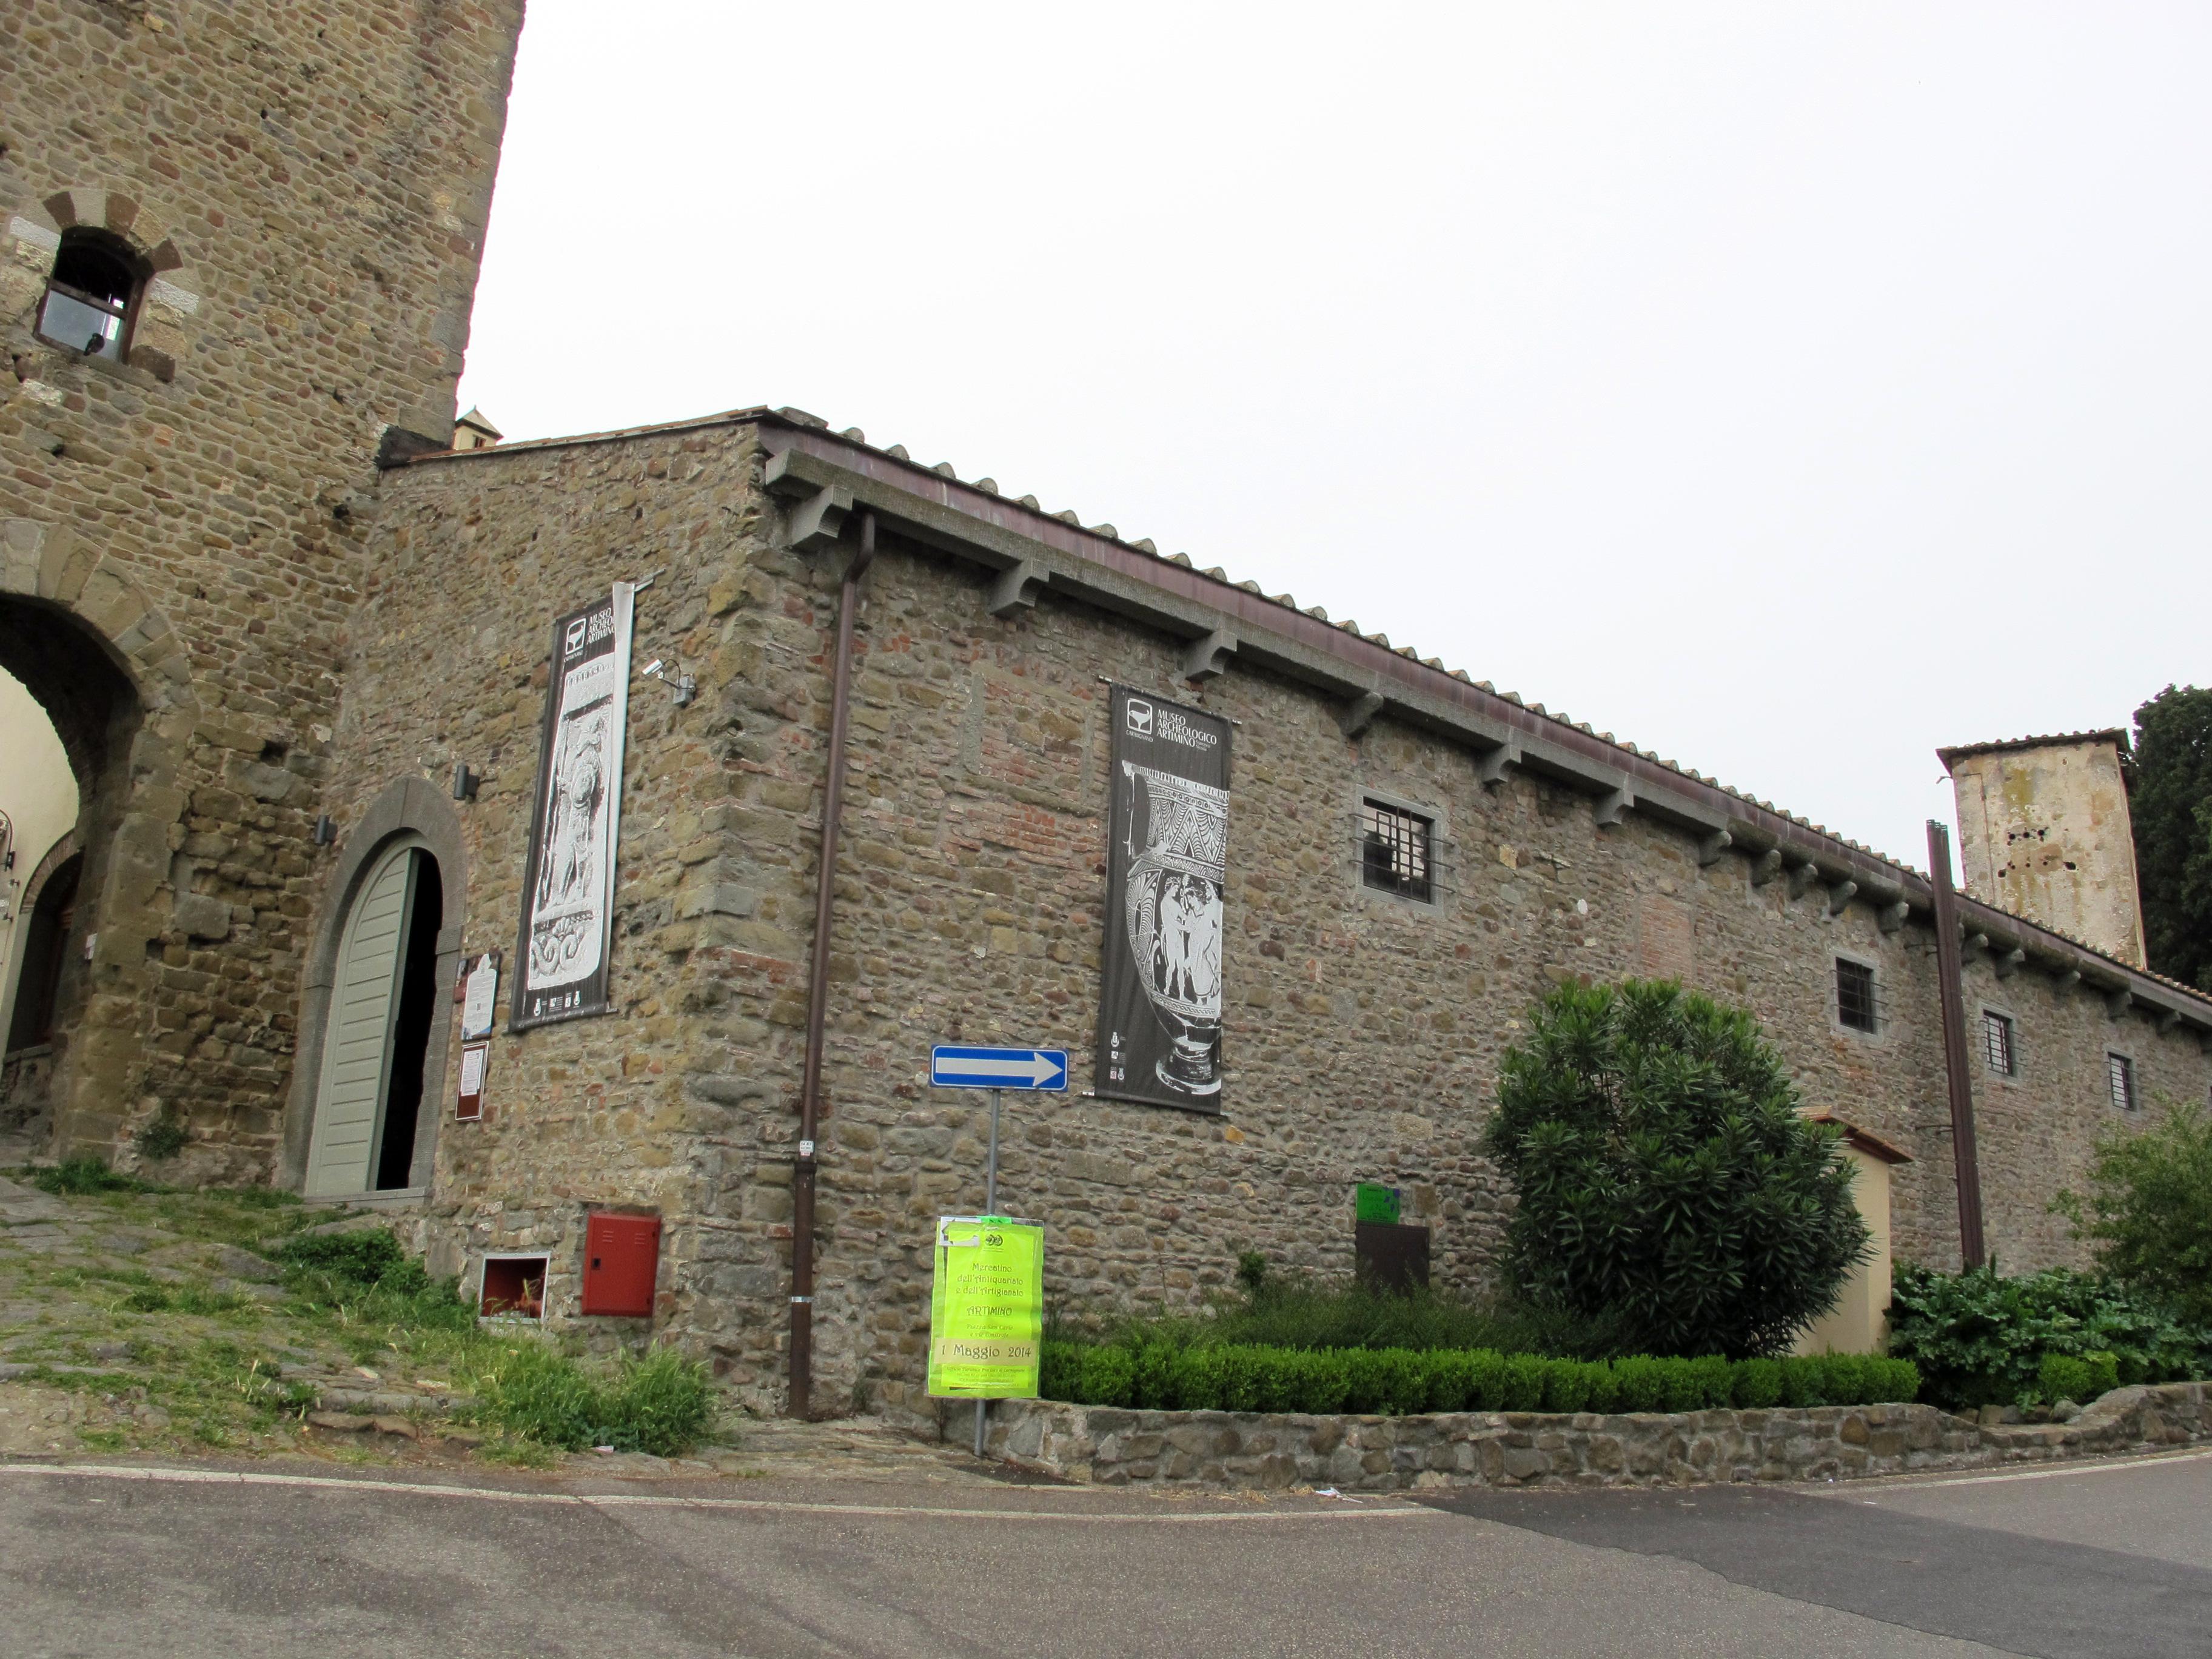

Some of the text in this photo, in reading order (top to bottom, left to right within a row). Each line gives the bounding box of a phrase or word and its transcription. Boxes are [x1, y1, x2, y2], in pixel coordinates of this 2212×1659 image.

[589, 607, 612, 626] MUSEO
[1157, 709, 1186, 726] MUSEO
[1156, 728, 1196, 748] ARTIMINO
[1157, 719, 1217, 745] ARCHEOLOGICO
[972, 1262, 1012, 1272] Mercatino
[957, 1274, 1024, 1285] dell'Antiquariato
[963, 1286, 1024, 1297] dell'Artigianato
[966, 1305, 1012, 1316] ARTIMINO
[941, 1344, 1031, 1360] 1 Maggio 2014
